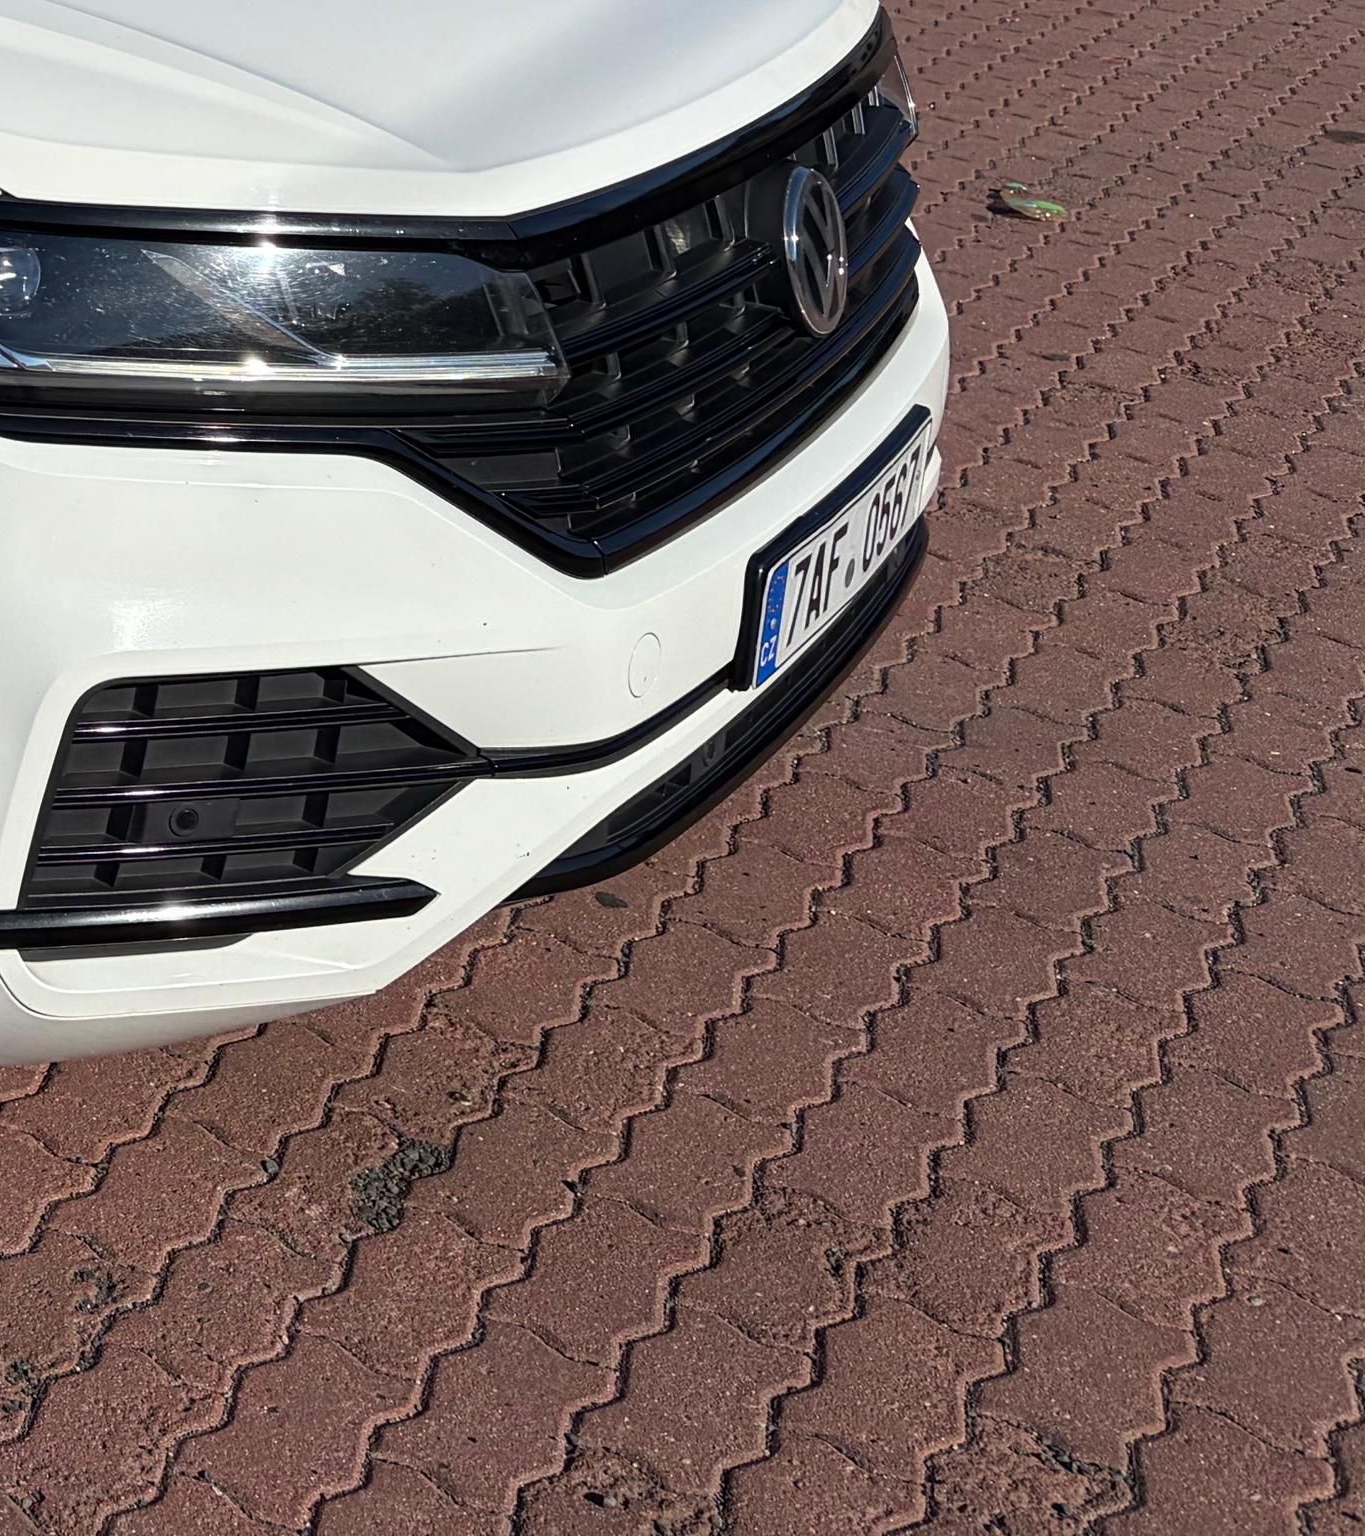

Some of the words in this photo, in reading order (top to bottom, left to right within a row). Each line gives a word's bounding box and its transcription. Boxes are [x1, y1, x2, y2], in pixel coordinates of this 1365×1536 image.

[786, 522, 848, 648] 7AF
[863, 444, 922, 572] 0567
[760, 635, 777, 667] CZ
